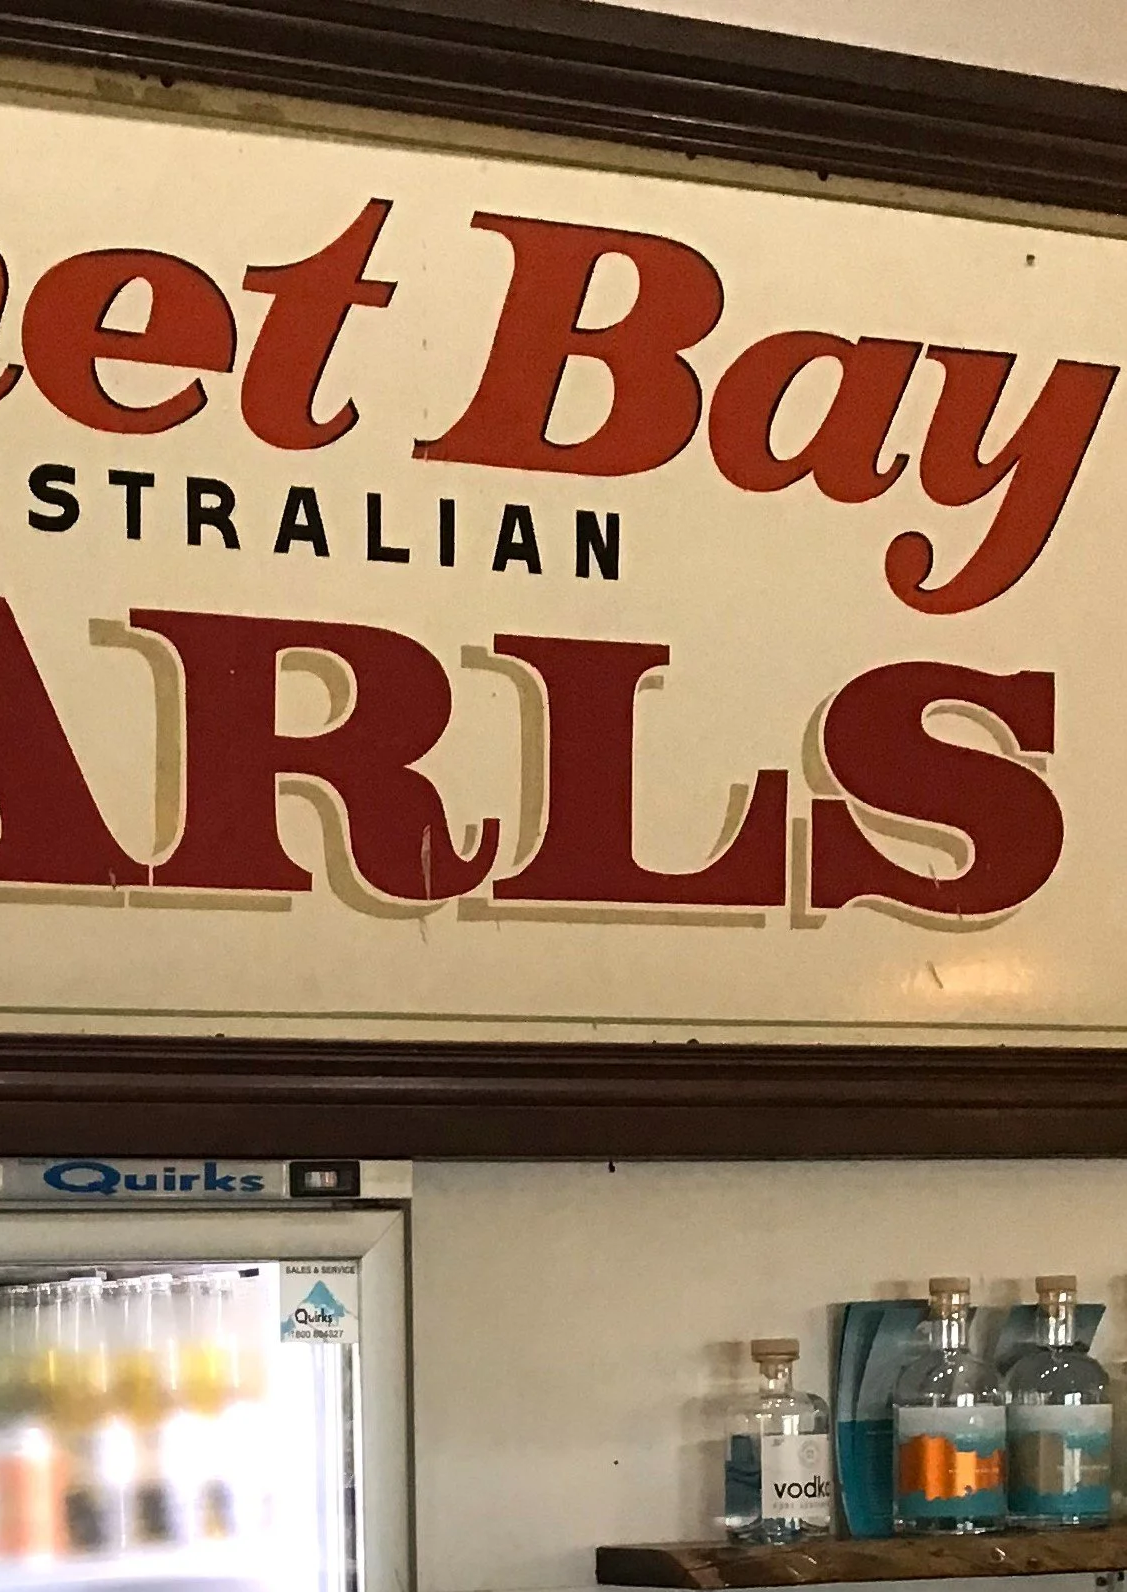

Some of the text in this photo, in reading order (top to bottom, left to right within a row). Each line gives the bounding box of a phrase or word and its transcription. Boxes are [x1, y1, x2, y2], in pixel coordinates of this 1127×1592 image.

[411, 211, 1121, 615] Bay
[43, 1160, 266, 1196] Quirks
[285, 1266, 312, 1274] SALES
[321, 1265, 356, 1274] SERVICE
[294, 1308, 334, 1325] Quirks
